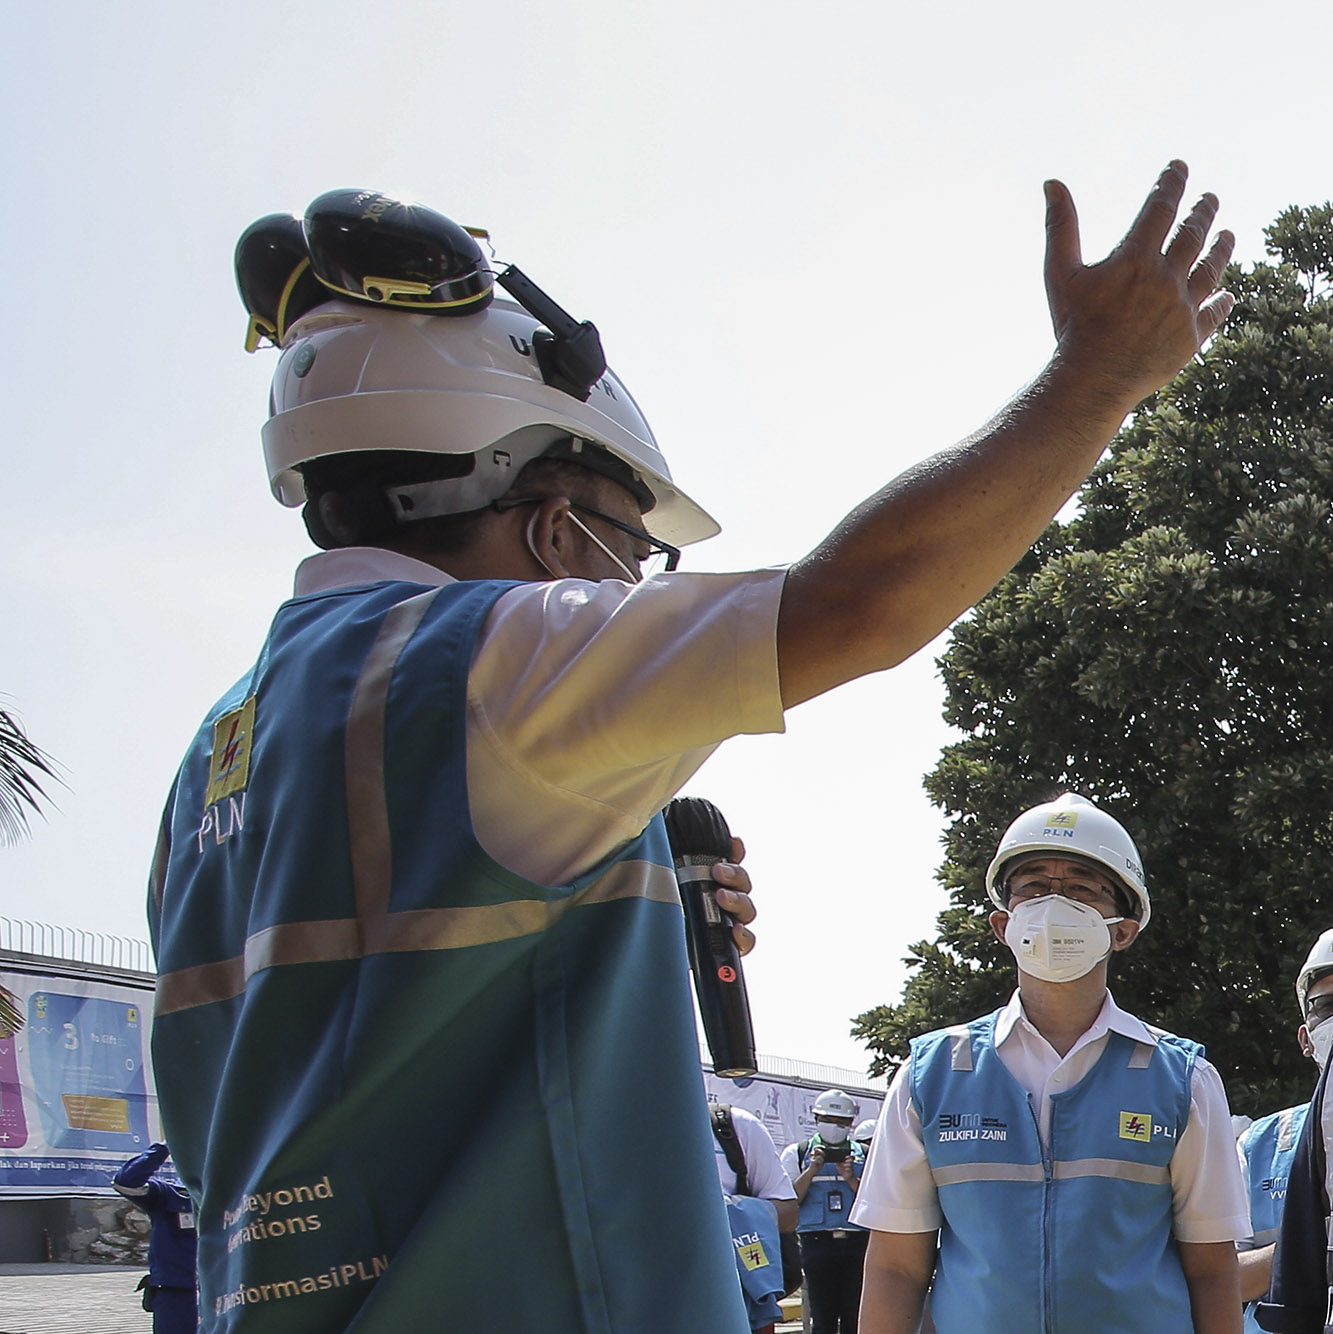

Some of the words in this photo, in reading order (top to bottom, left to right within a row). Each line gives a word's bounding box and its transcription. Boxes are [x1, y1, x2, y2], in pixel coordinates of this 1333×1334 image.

[198, 791, 246, 854] PLN
[1043, 829, 1074, 838] PLN
[723, 967, 732, 979] 3
[939, 1130, 979, 1142] ZULKIFLI
[981, 1130, 1007, 1141] ZAINI
[732, 1231, 760, 1248] PLN
